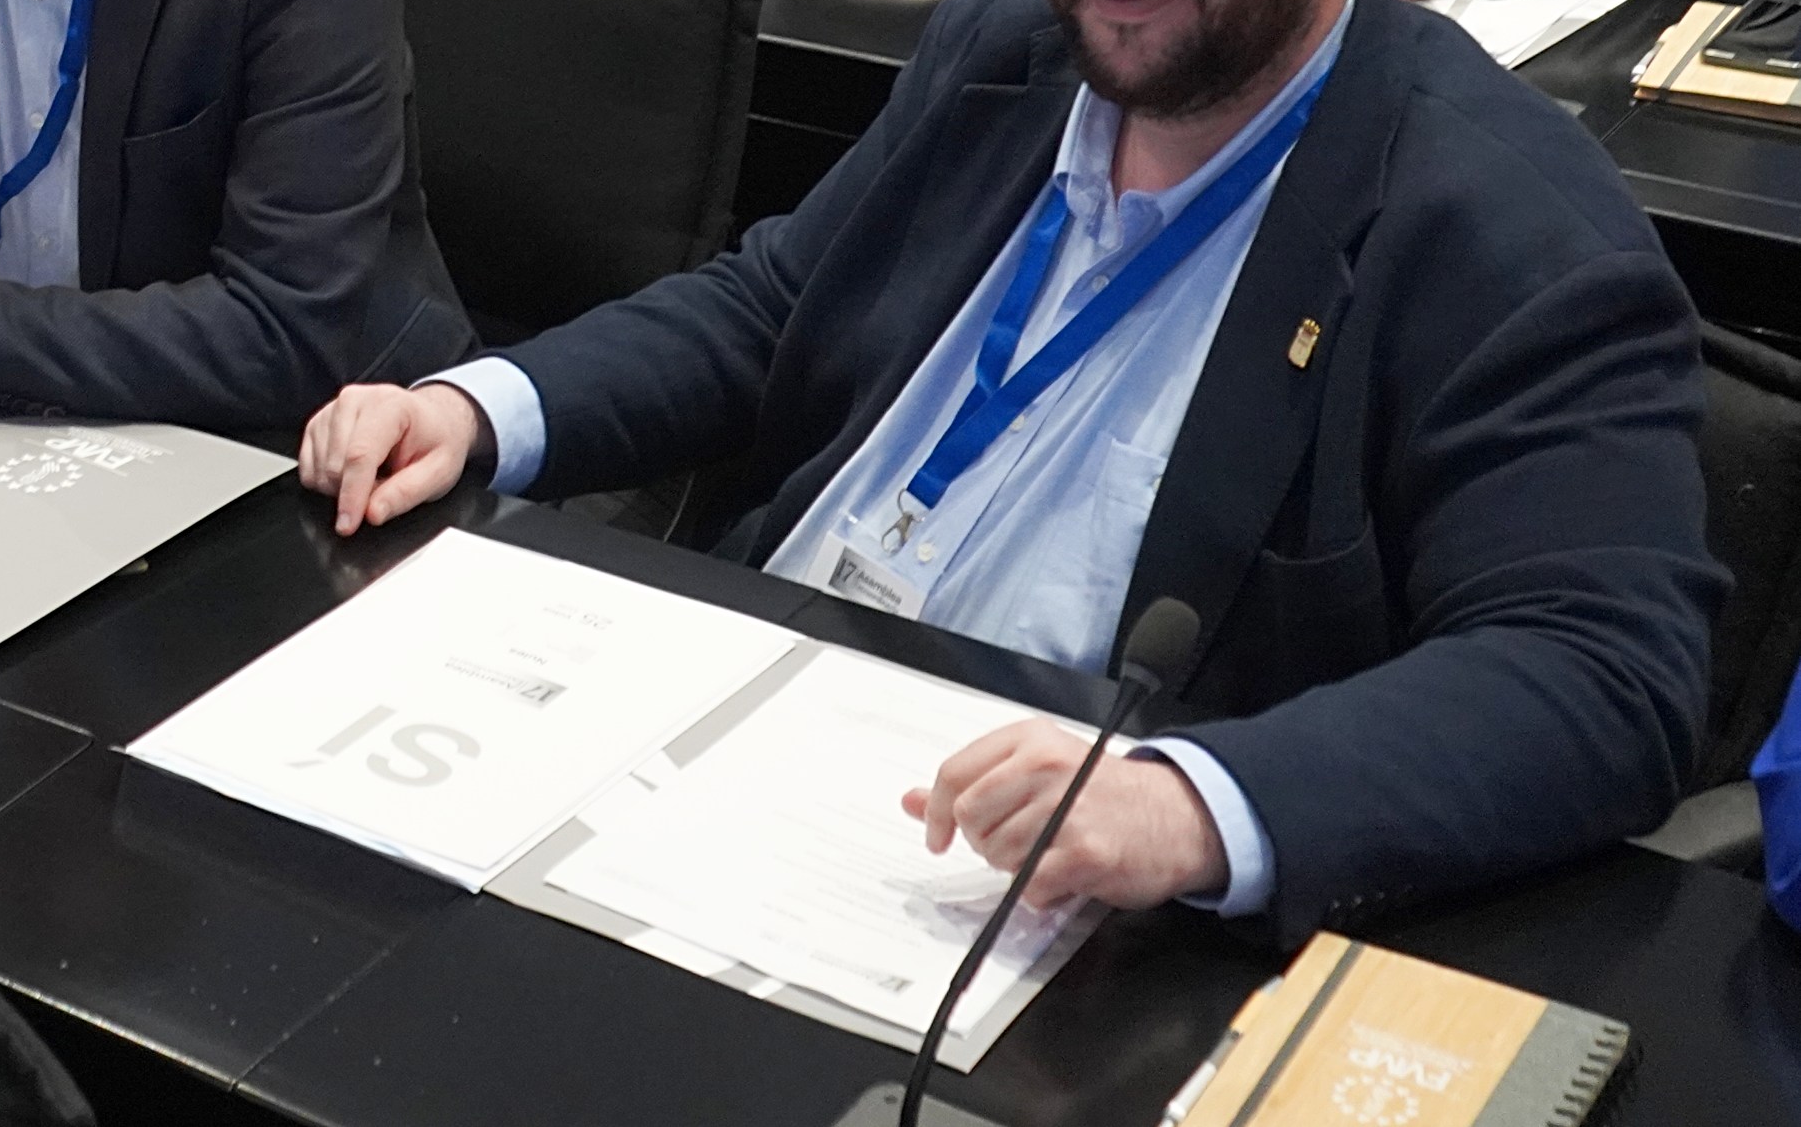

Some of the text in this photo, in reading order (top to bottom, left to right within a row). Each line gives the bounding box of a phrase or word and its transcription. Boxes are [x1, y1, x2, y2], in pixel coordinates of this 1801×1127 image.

[835, 558, 857, 583] 17
[857, 570, 902, 605] Asamblea
[520, 685, 556, 703] 17
[288, 704, 482, 787] SÍ
